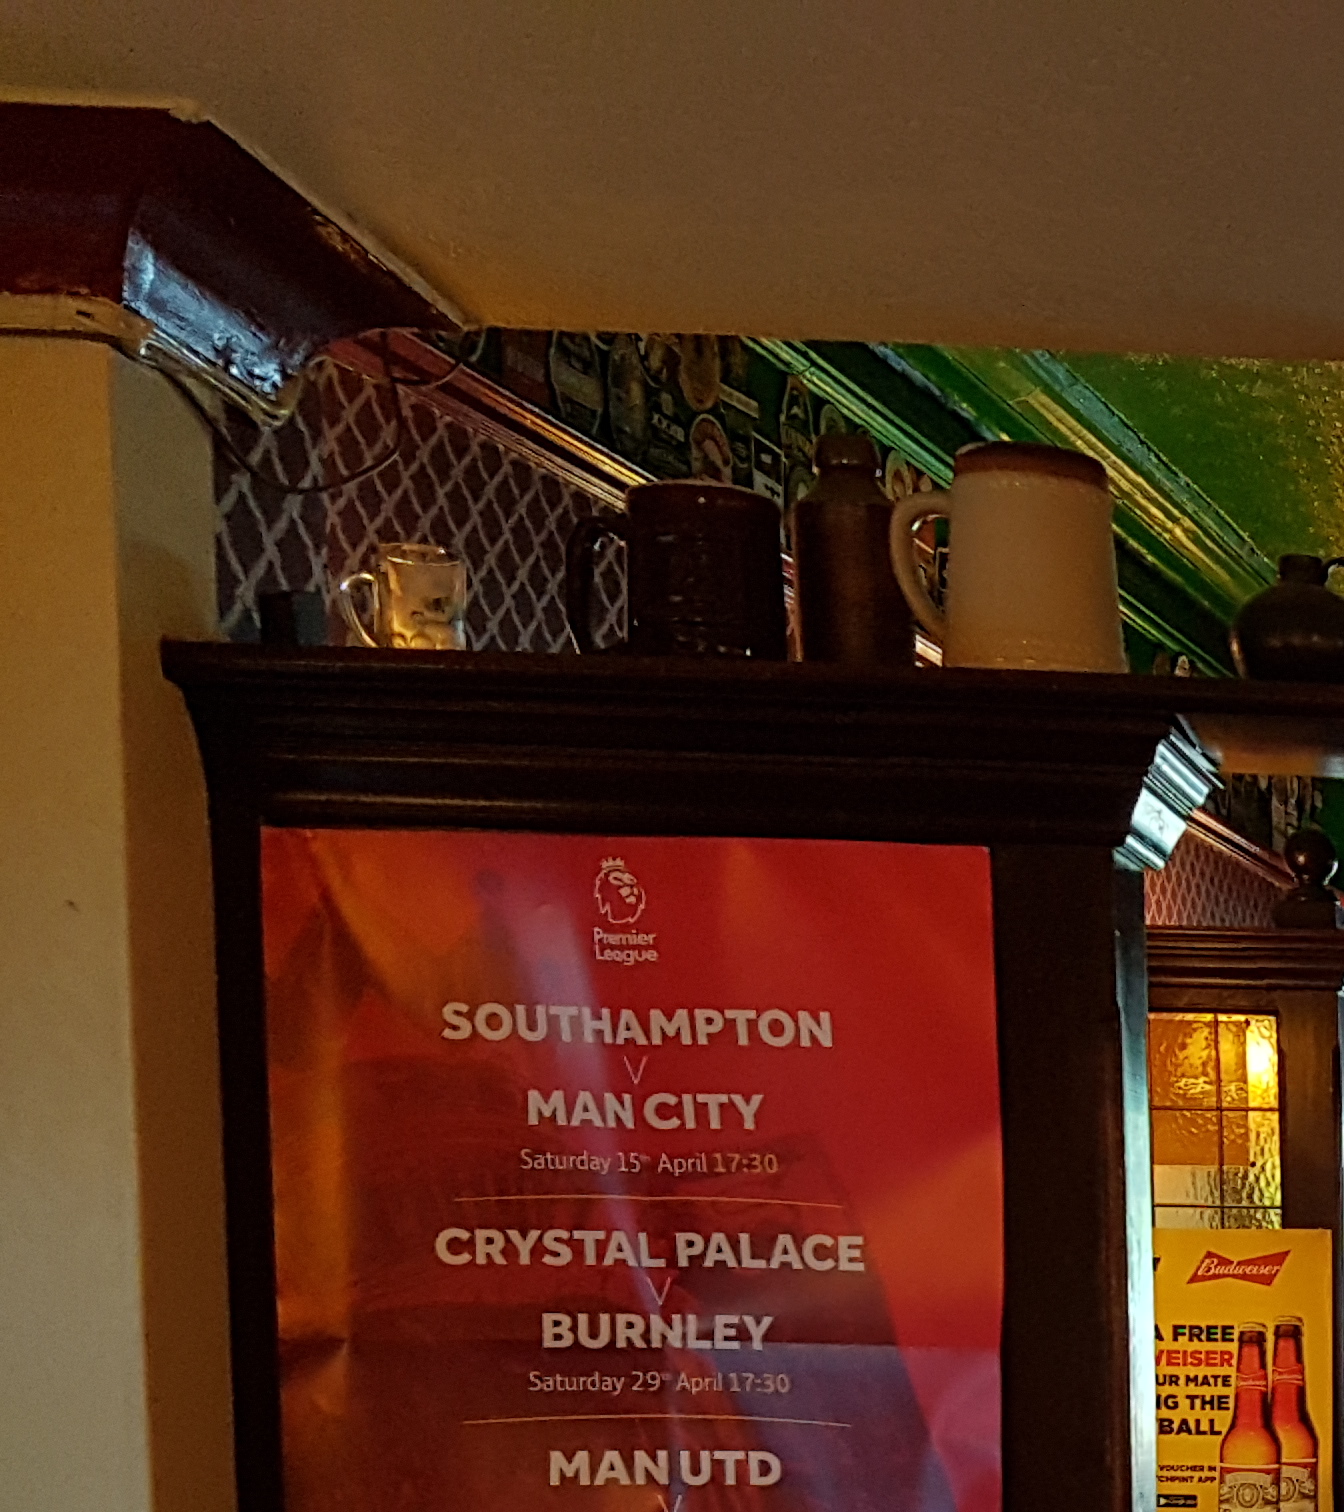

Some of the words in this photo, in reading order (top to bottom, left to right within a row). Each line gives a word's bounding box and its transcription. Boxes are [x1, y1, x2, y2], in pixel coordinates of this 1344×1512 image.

[593, 927, 656, 945] Premier
[595, 948, 659, 965] League
[440, 1002, 833, 1048] SOUTHAMPTON
[525, 1090, 635, 1131] MAN
[643, 1092, 765, 1131] CITY
[520, 1149, 611, 1175] Saturday
[657, 1152, 707, 1177] April
[713, 1153, 779, 1174] 17:30
[435, 1227, 667, 1269] CRYSTAL
[675, 1232, 865, 1272] PALACE
[1197, 1257, 1282, 1276] Budweiser
[541, 1312, 774, 1351] BURNLEY
[1172, 1325, 1235, 1342] FREE
[528, 1371, 625, 1395] Saturday
[676, 1372, 722, 1395] April
[728, 1373, 791, 1394] 17:30
[1185, 1374, 1233, 1387] MATE
[1185, 1394, 1231, 1411] THE
[548, 1450, 670, 1486] MAN
[679, 1451, 783, 1486] UTD
[1156, 1475, 1194, 1483] CHPINT
